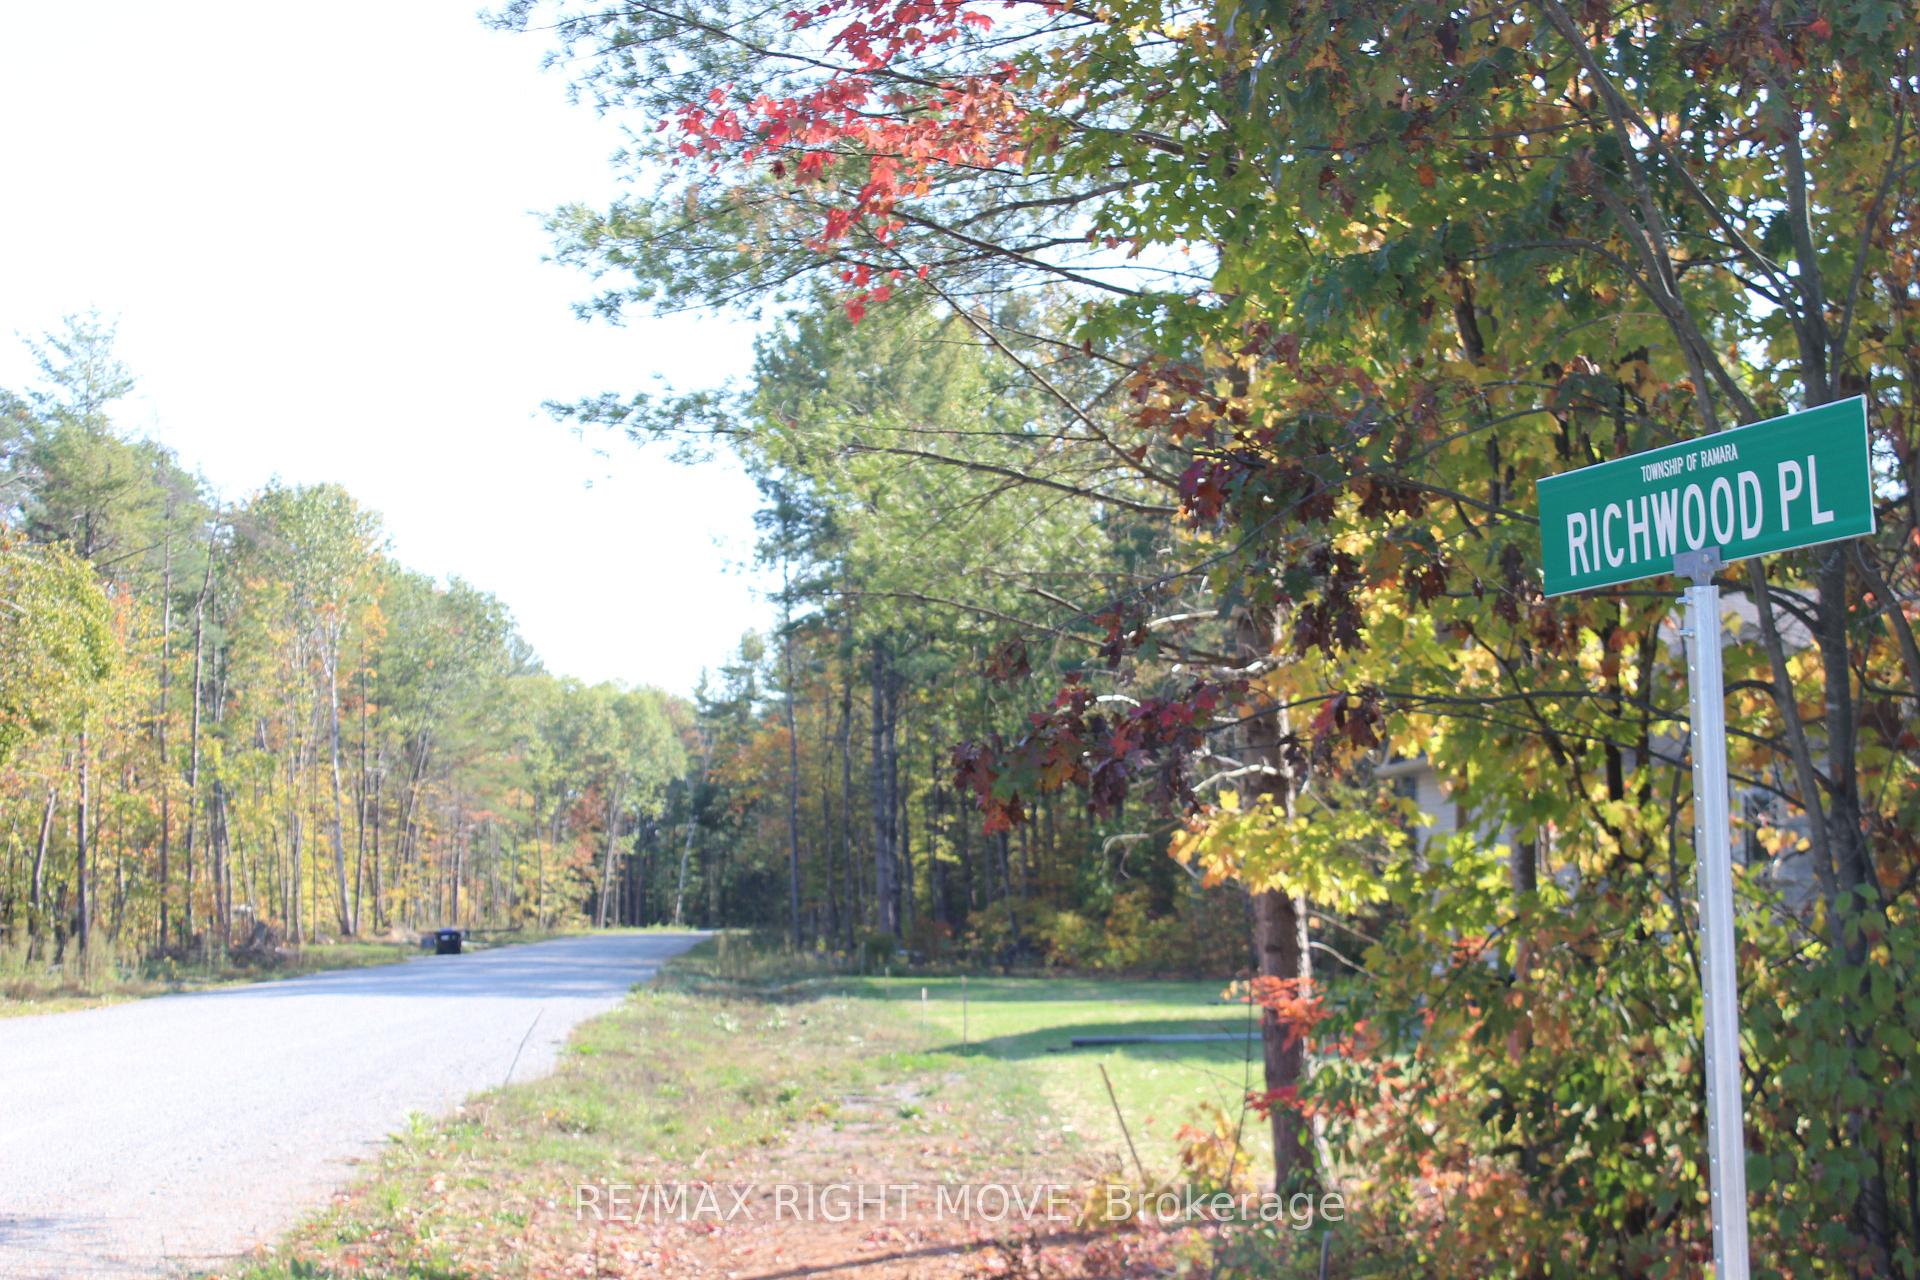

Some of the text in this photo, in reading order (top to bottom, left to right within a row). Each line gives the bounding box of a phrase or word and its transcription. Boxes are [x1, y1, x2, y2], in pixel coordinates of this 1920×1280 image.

[1640, 442, 1739, 482] TOWNSHIP OF RAMARA
[1567, 455, 1835, 576] RICHWOOD PL
